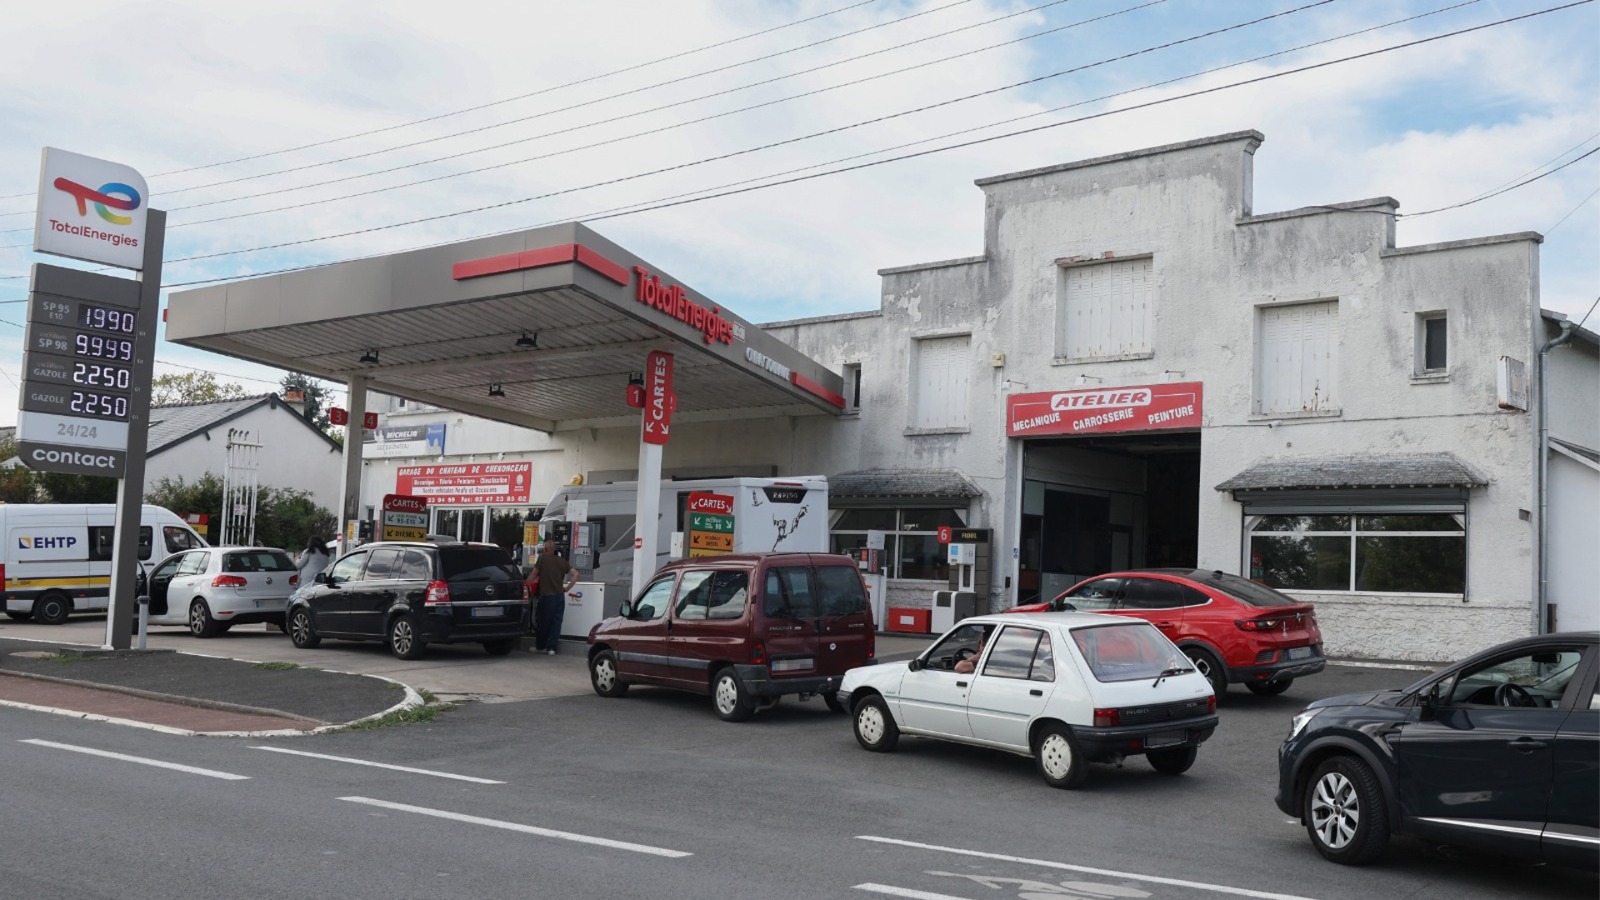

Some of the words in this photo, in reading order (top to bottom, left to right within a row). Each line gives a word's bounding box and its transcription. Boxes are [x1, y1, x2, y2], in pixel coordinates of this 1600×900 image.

[49, 219, 138, 247] TotalEnergies
[43, 301, 56, 311] SP
[58, 304, 70, 314] 95
[633, 265, 734, 345] TotalEnergies
[50, 312, 63, 320] E10
[86, 308, 135, 333] 1.990
[38, 338, 52, 347] SP
[55, 341, 67, 350] 98
[76, 334, 132, 361] 9.999
[33, 368, 68, 379] GAZOLE
[73, 363, 129, 389] 2.250
[653, 356, 667, 421] CARTES
[31, 393, 65, 404] GAZOLE
[633, 389, 639, 403] 1
[1055, 391, 1149, 408] ATELIER
[71, 392, 127, 417] 2.250
[336, 411, 342, 422] 3
[367, 415, 374, 426] 4
[1013, 412, 1061, 432] MECANIQUE
[1073, 408, 1134, 430] CARROSSERIE
[1148, 405, 1195, 425] PEINTURE
[57, 423, 97, 439] 24/24
[386, 430, 418, 439] MICHELIN
[32, 449, 116, 468] contact
[399, 468, 422, 476] GARAGE
[426, 467, 435, 475] DU
[439, 466, 467, 475] CHATEAU
[485, 464, 528, 473] CHENONCEAU
[392, 499, 419, 509] CARTES
[698, 499, 725, 510] CARTES
[941, 529, 948, 540] 6
[34, 537, 77, 549] EHTP
